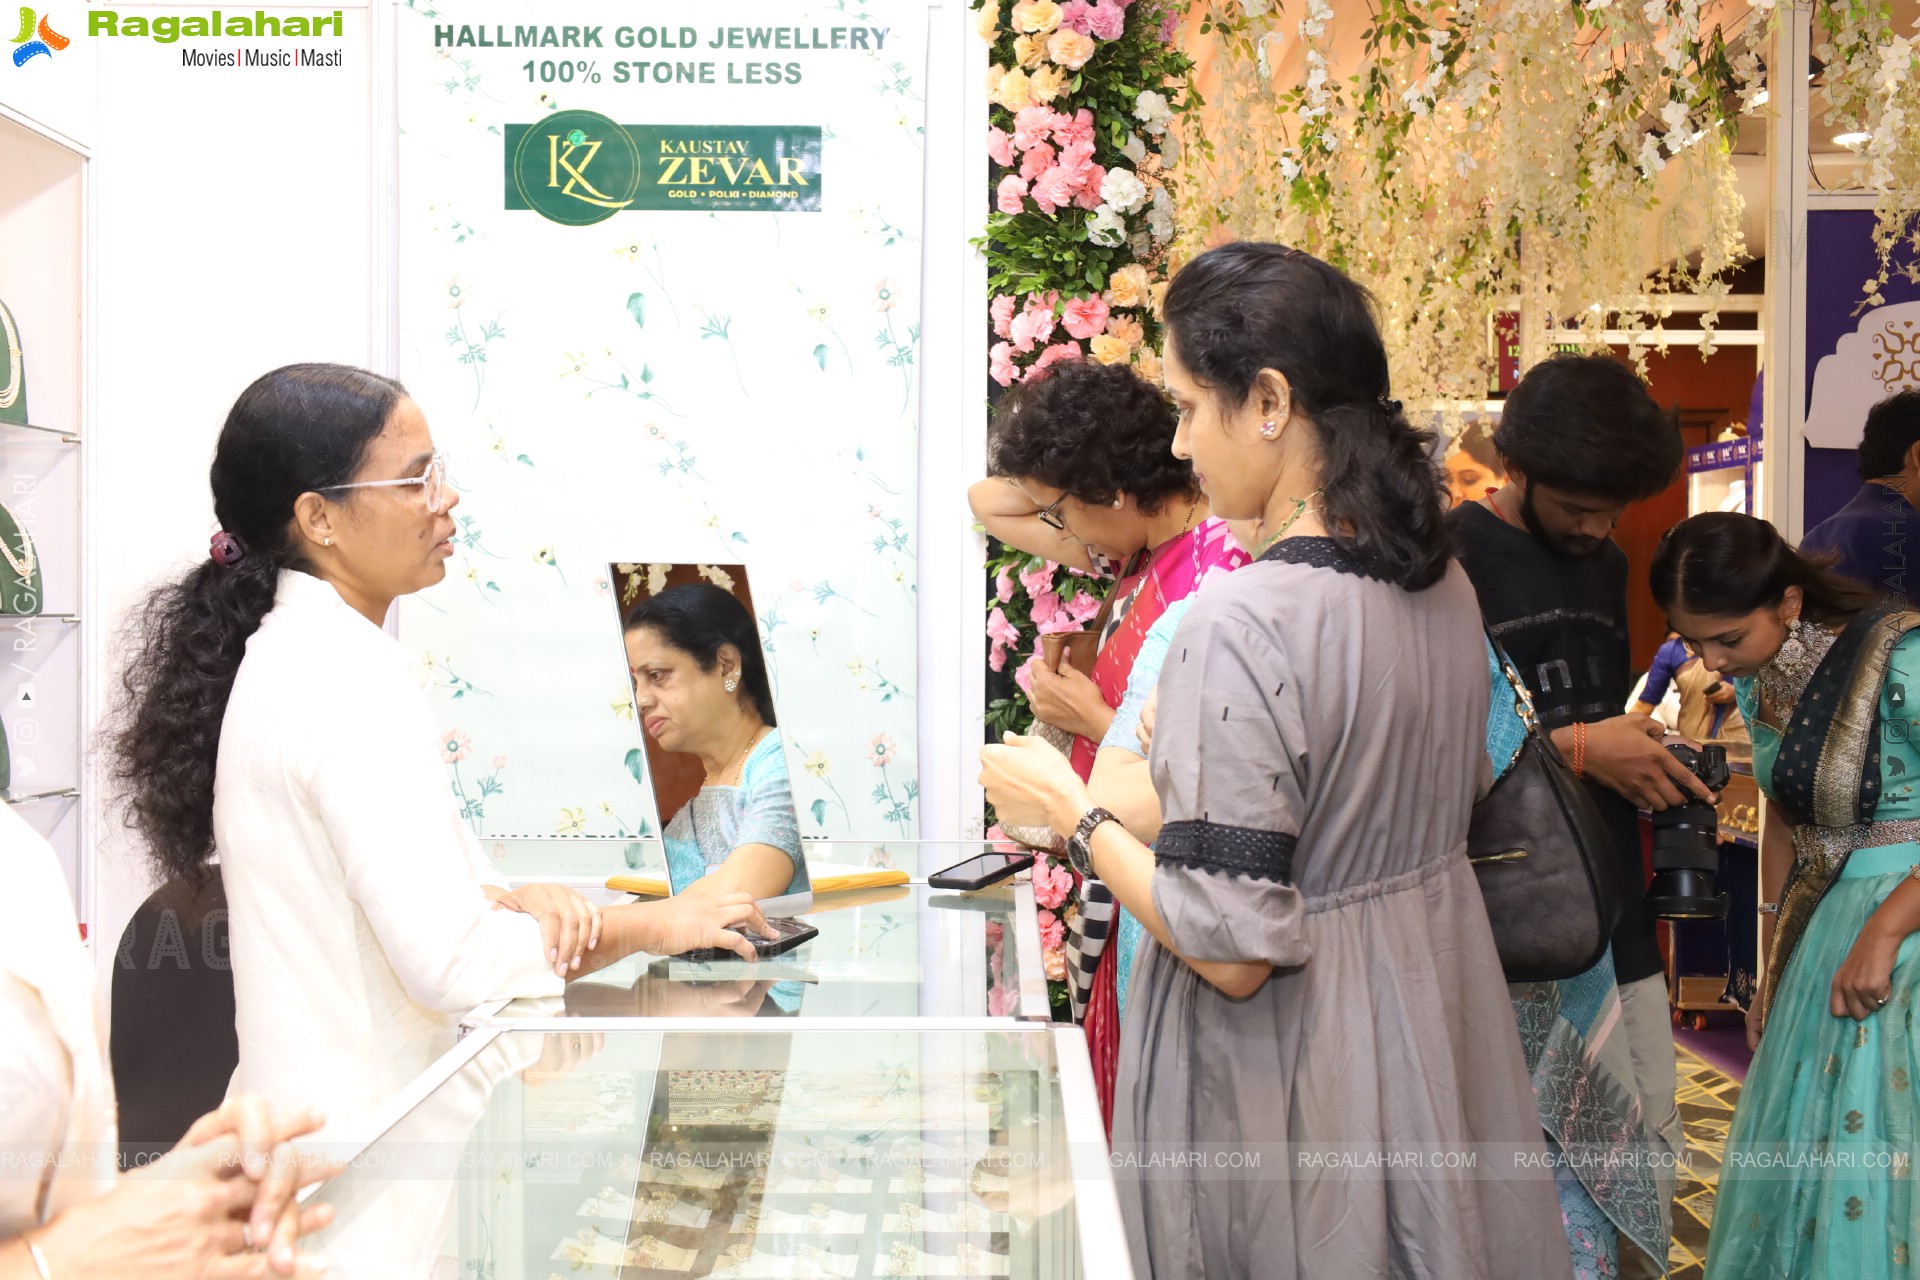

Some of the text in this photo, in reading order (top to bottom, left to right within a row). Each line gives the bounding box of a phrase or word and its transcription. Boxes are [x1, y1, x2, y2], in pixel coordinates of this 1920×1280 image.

[434, 24, 891, 50] HALLMARK GOLD JEWELLERY
[522, 60, 803, 85] 100% STONE LESS
[660, 140, 750, 154] KAUSTAV
[656, 156, 810, 186] ZEVAR
[668, 190, 799, 199] GOLD POLKI DIAMOND
